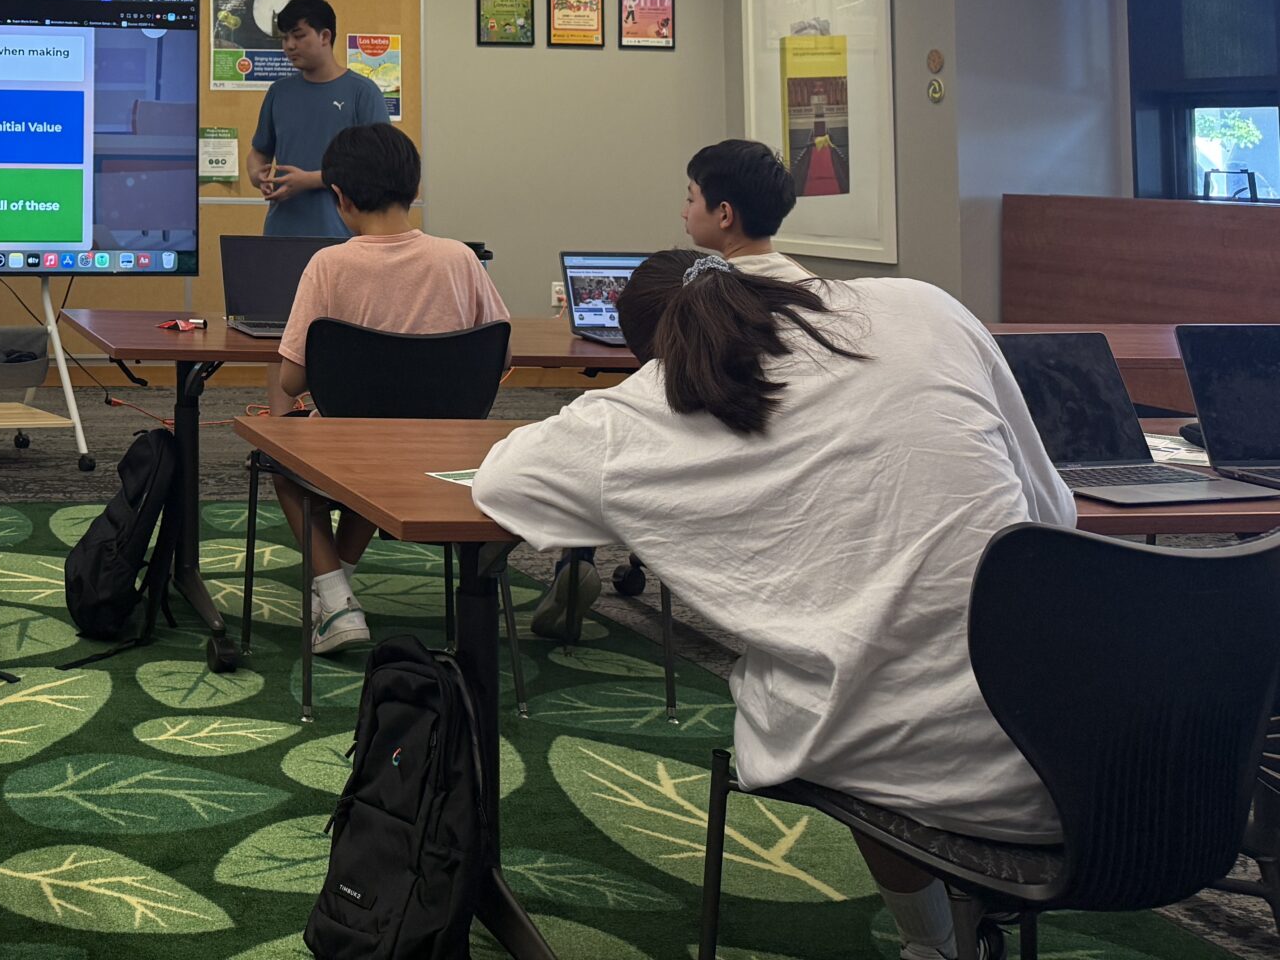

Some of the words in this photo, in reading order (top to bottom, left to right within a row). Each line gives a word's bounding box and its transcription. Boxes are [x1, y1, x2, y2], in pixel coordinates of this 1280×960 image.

[28, 47, 70, 59] making
[27, 122, 62, 133] Value
[10, 200, 23, 211] of
[25, 200, 60, 212] these
[339, 884, 361, 900] TIMBUK2
